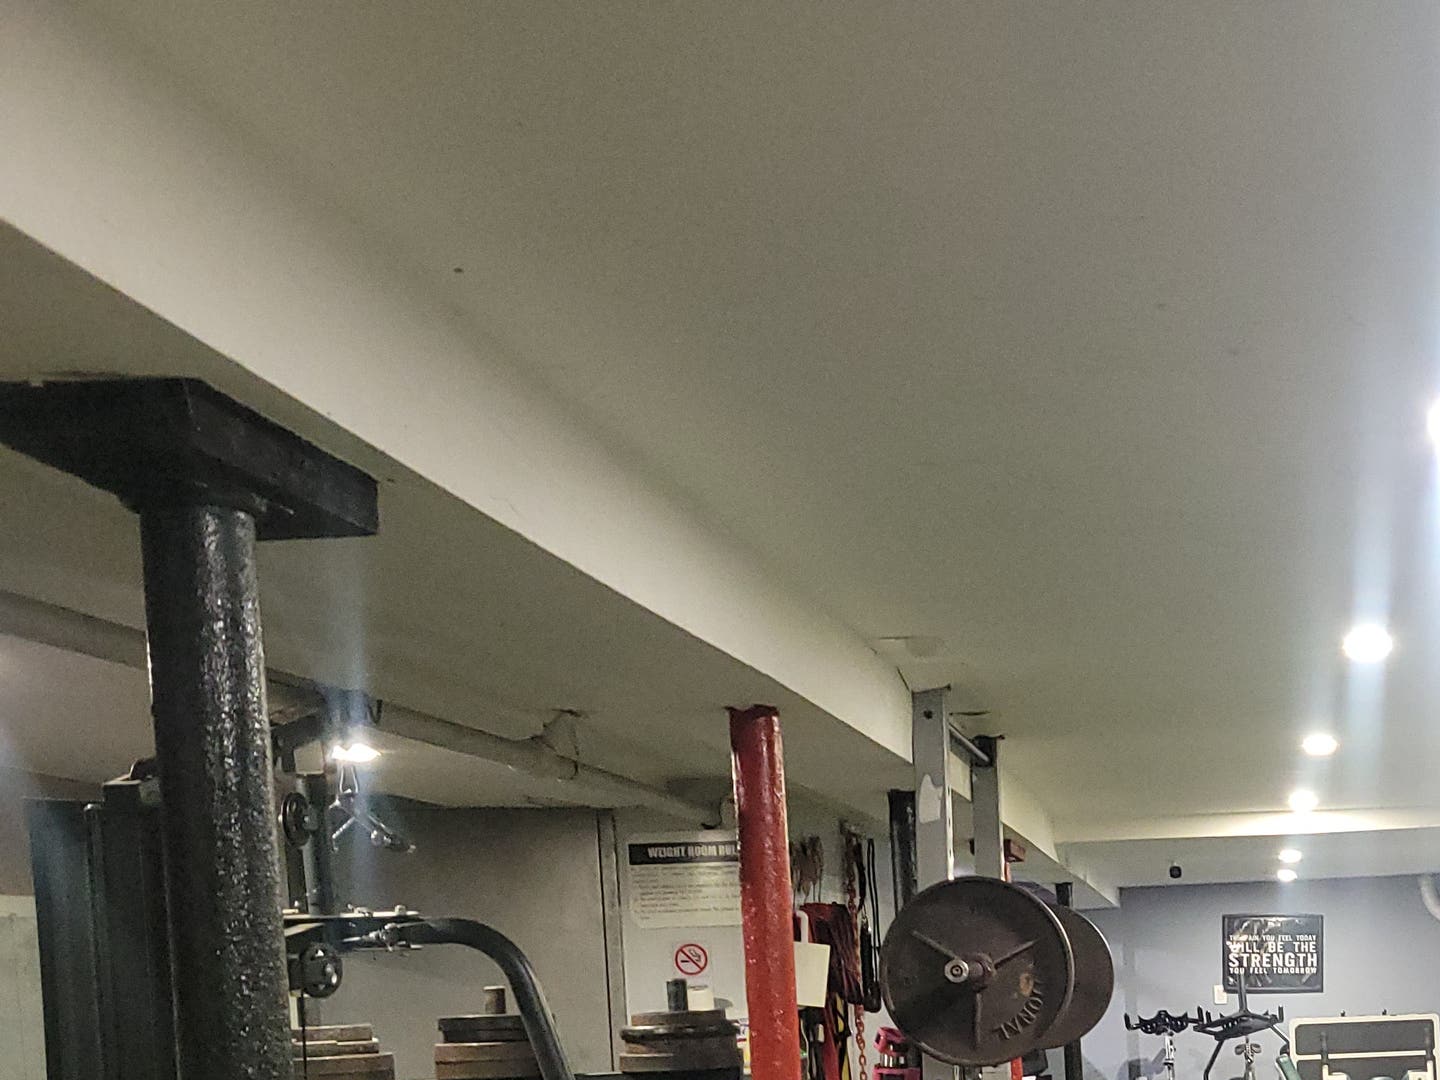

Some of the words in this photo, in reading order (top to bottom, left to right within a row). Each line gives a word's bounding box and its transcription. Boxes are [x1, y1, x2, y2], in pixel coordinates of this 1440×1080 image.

[647, 846, 685, 858] WEIGHT
[688, 845, 717, 857] ROOM
[719, 844, 737, 856] RUL
[1228, 941, 1260, 953] WILL
[1268, 942, 1284, 953] BE
[1293, 941, 1316, 953] THE
[1228, 952, 1317, 967] STRENGTH
